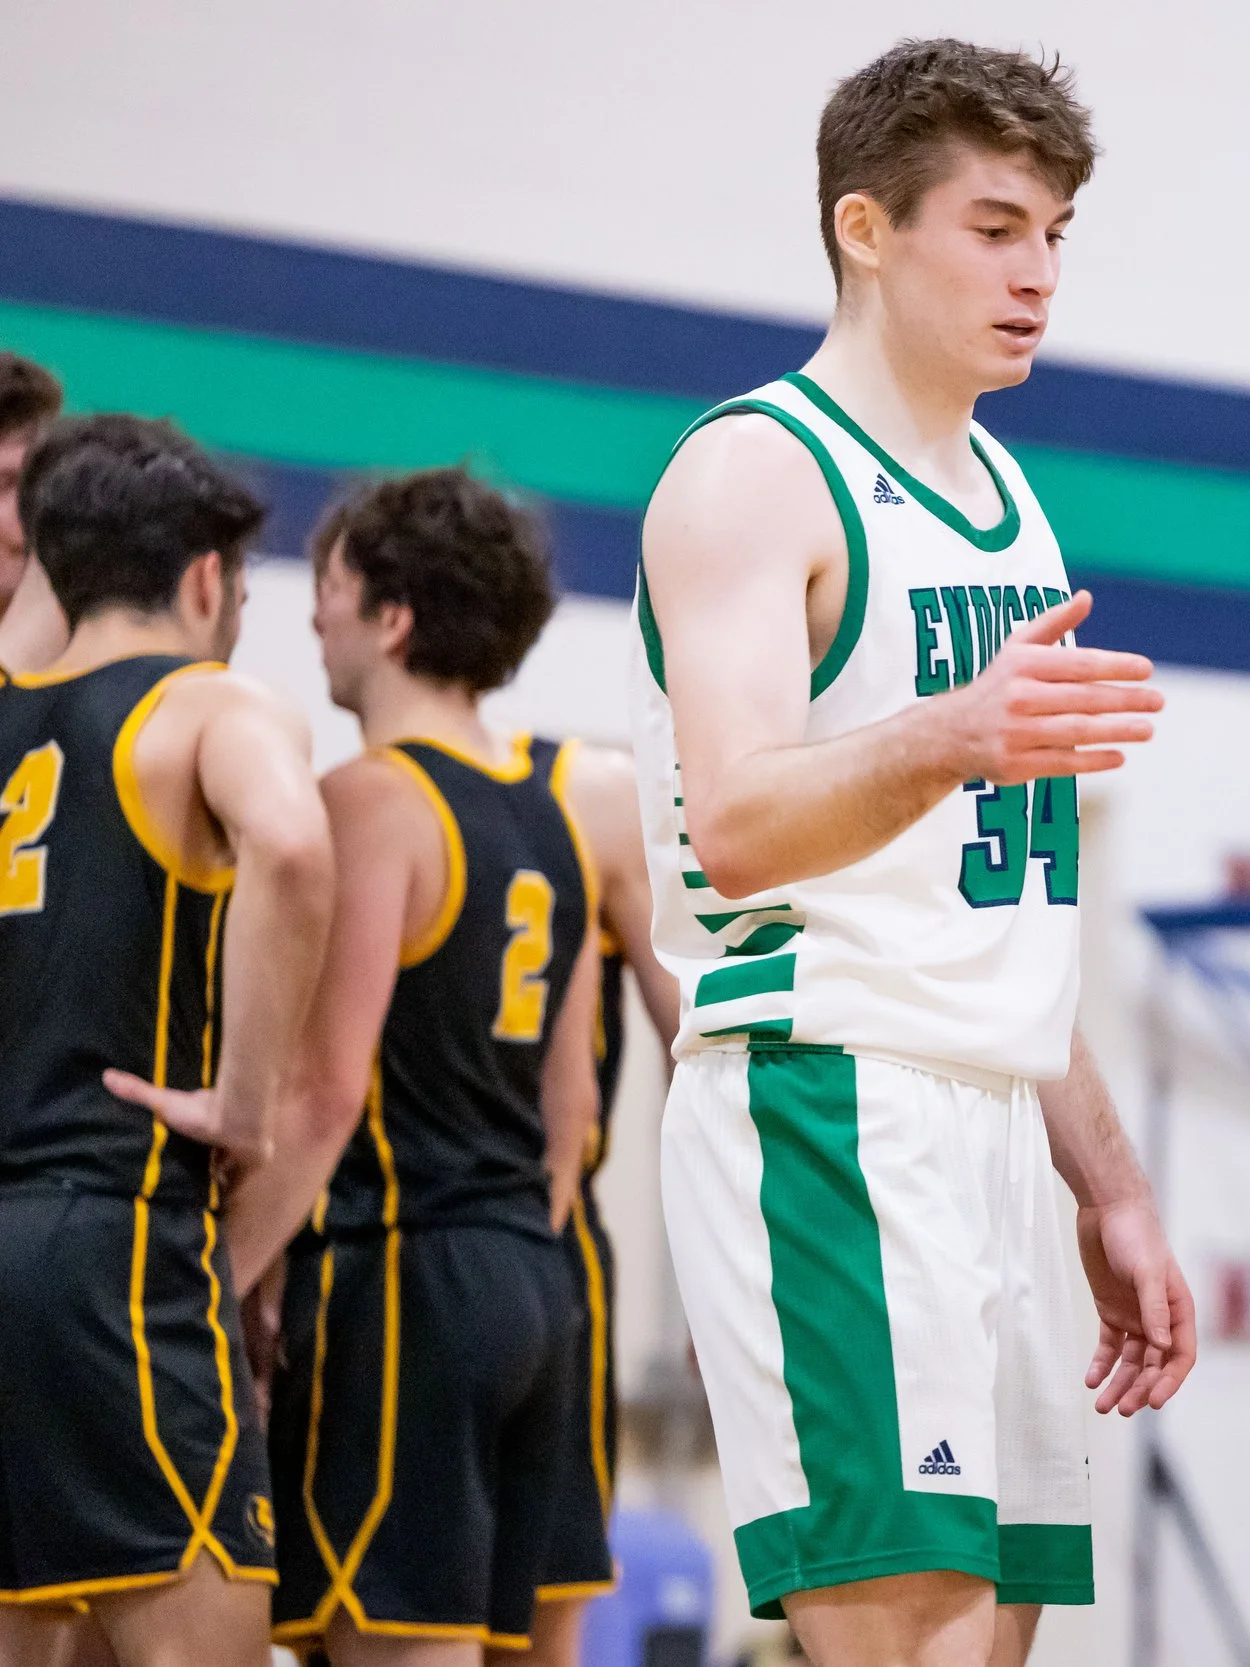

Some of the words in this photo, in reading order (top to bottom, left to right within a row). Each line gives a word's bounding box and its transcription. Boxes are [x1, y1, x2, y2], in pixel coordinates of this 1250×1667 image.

[957, 773, 1079, 909] 34
[491, 868, 556, 1042] 2
[918, 1462, 961, 1475] adidas
